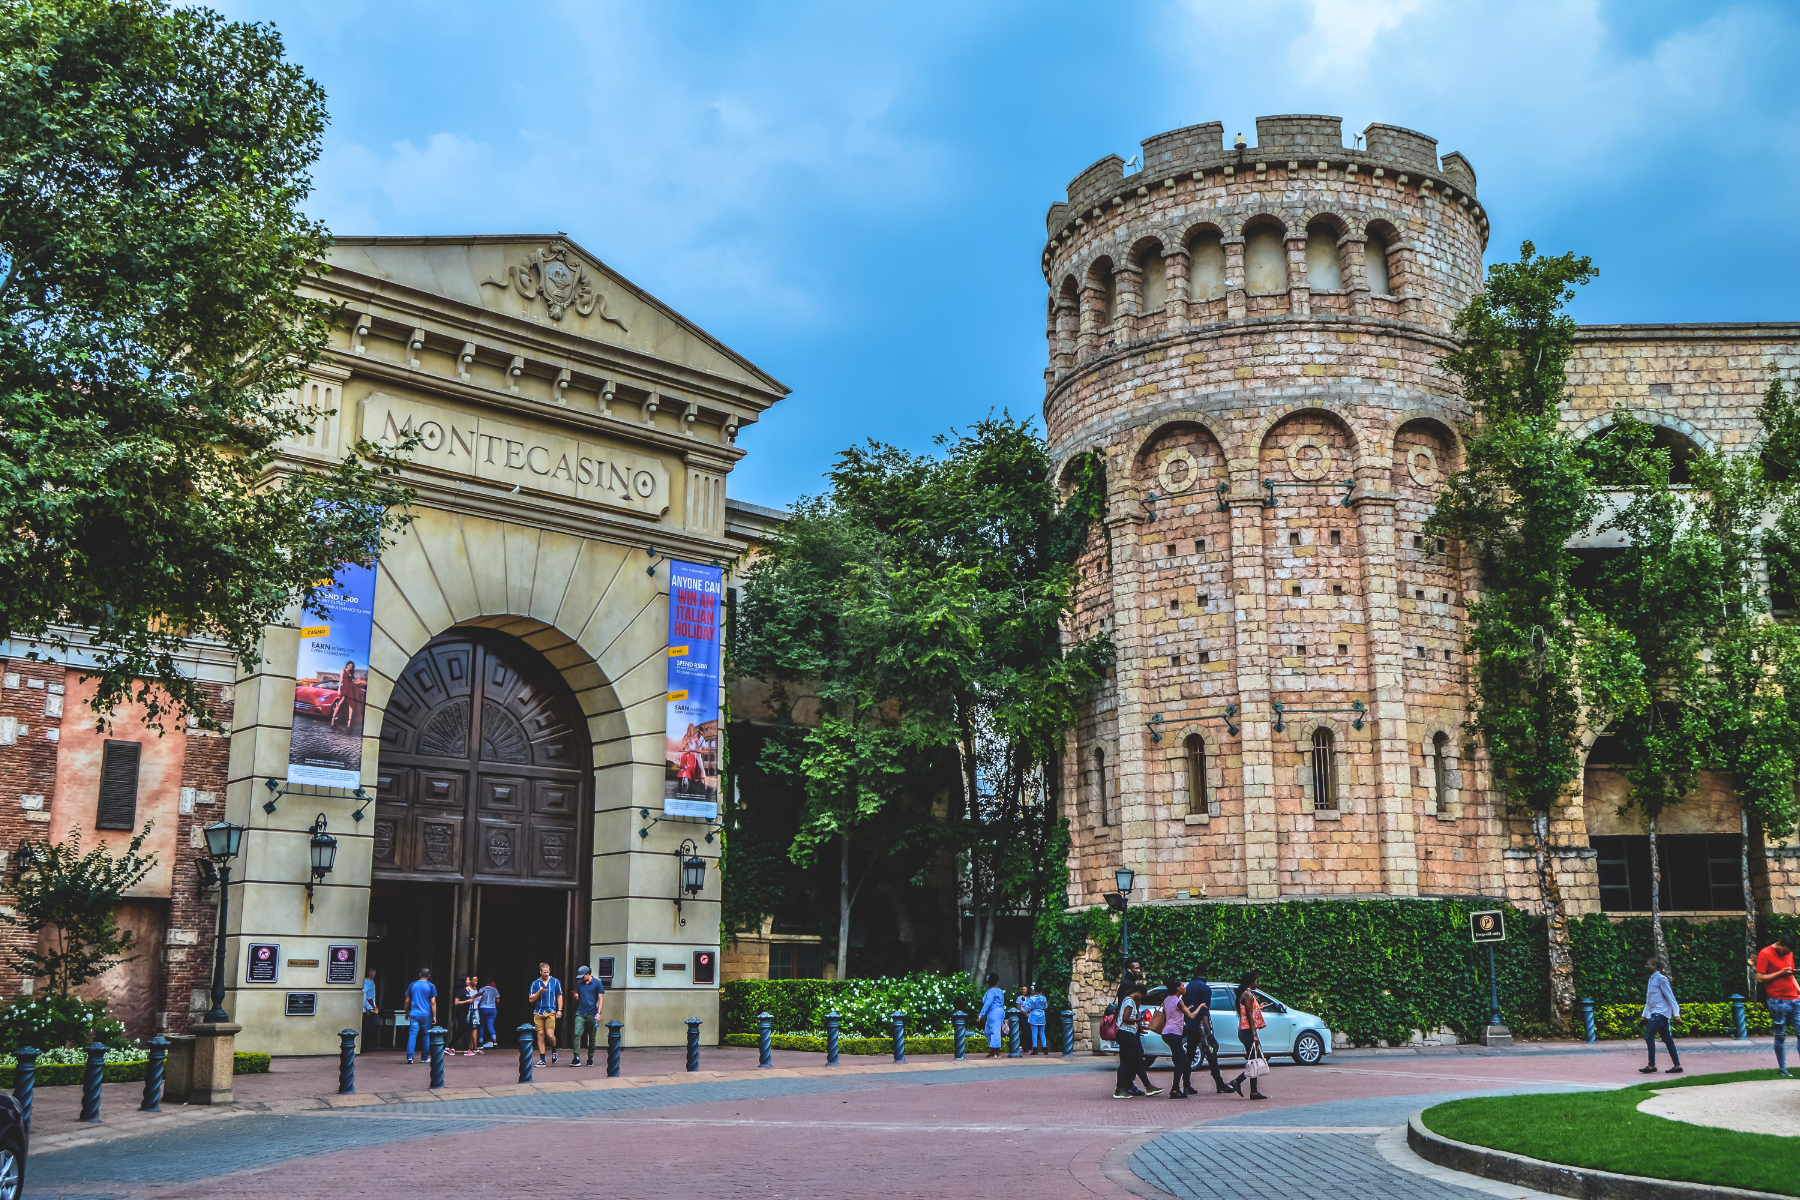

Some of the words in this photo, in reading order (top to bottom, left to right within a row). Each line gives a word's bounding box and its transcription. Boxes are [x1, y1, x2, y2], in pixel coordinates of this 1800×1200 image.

[379, 409, 656, 499] MONTECASINO
[672, 575, 703, 591] ANYONE
[705, 581, 720, 594] CAN
[678, 589, 697, 606] WIN
[700, 593, 714, 609] AN
[676, 605, 714, 625] ITALIAN
[674, 621, 715, 642] HOLIDAY
[312, 642, 330, 650] EARN
